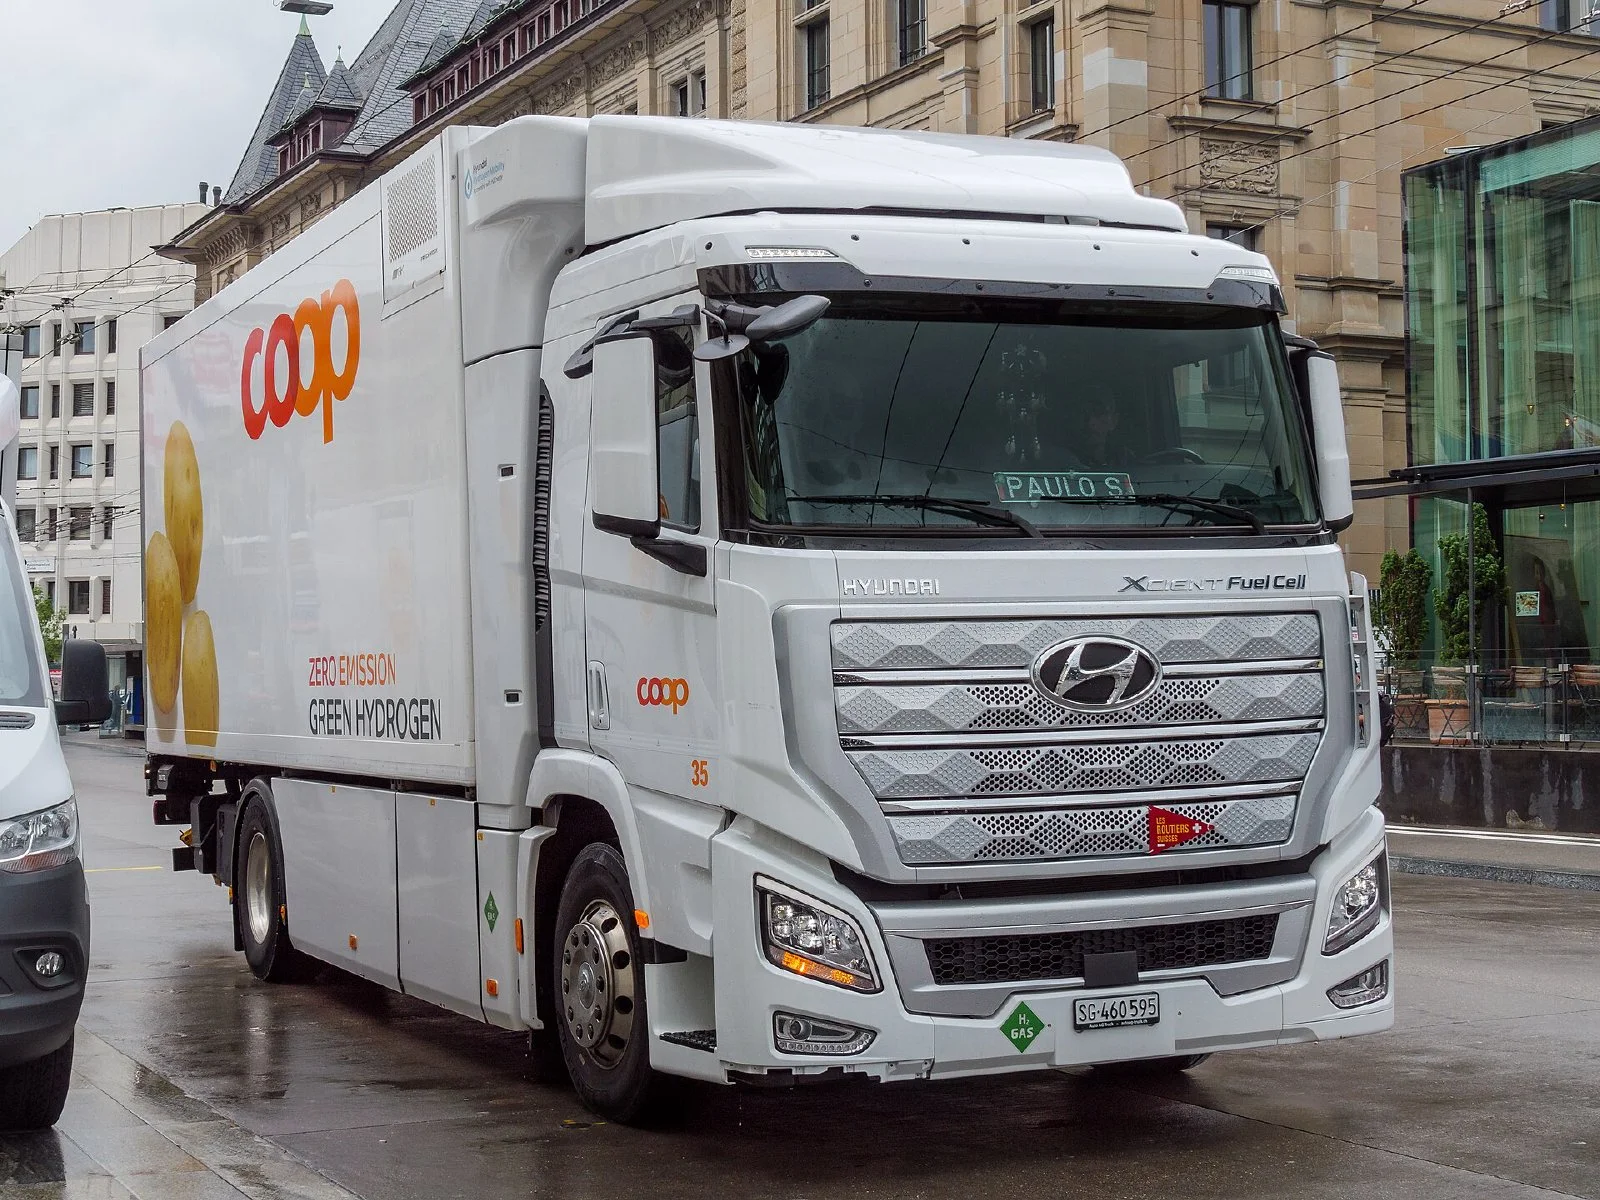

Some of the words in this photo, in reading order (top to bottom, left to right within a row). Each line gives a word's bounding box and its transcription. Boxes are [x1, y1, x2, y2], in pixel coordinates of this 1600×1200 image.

[241, 278, 361, 444] coop
[1006, 476, 1096, 498] PAULO
[843, 579, 940, 596] HYUNDAI
[1118, 575, 1223, 592] XCIENT
[1227, 574, 1271, 591] Fuel
[1272, 574, 1306, 590] Cell
[308, 655, 336, 687] ZERO
[339, 652, 396, 686] EMISSION
[637, 677, 690, 715] coop
[309, 698, 351, 736] GREEN
[355, 697, 442, 741] HYDROGEN
[691, 759, 709, 787] 35
[1156, 817, 1165, 825] LES
[1156, 824, 1190, 835] ROUTIERS
[1157, 835, 1179, 843] SUISSES
[1010, 1026, 1034, 1040] GAS
